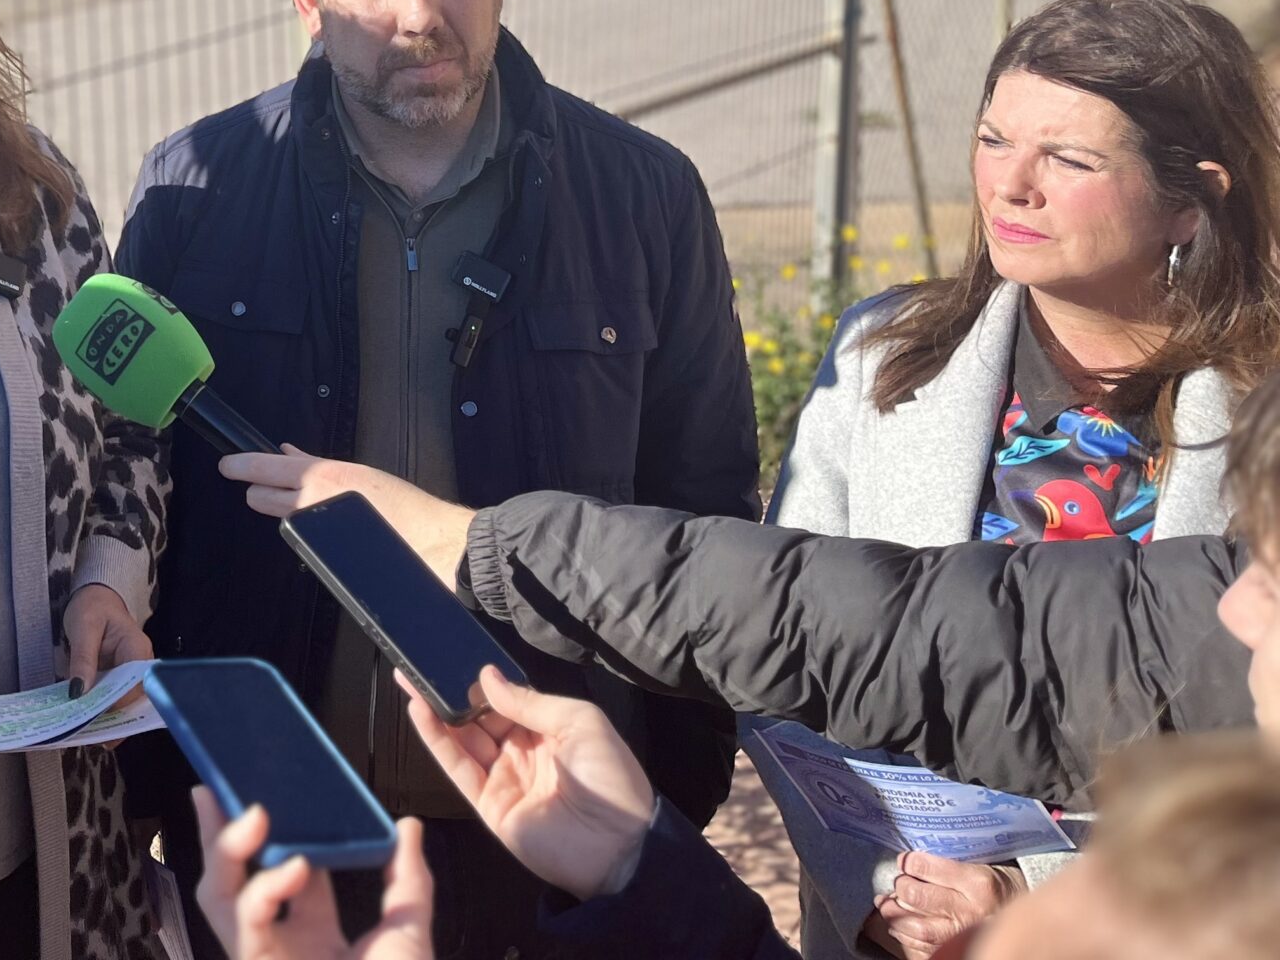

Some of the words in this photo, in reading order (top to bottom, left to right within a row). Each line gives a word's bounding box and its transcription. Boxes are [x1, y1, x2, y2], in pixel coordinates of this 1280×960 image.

[87, 314, 124, 357] ONDA
[105, 325, 140, 368] CERO
[881, 772, 907, 781] 30%
[890, 802, 941, 812] GASTADOS
